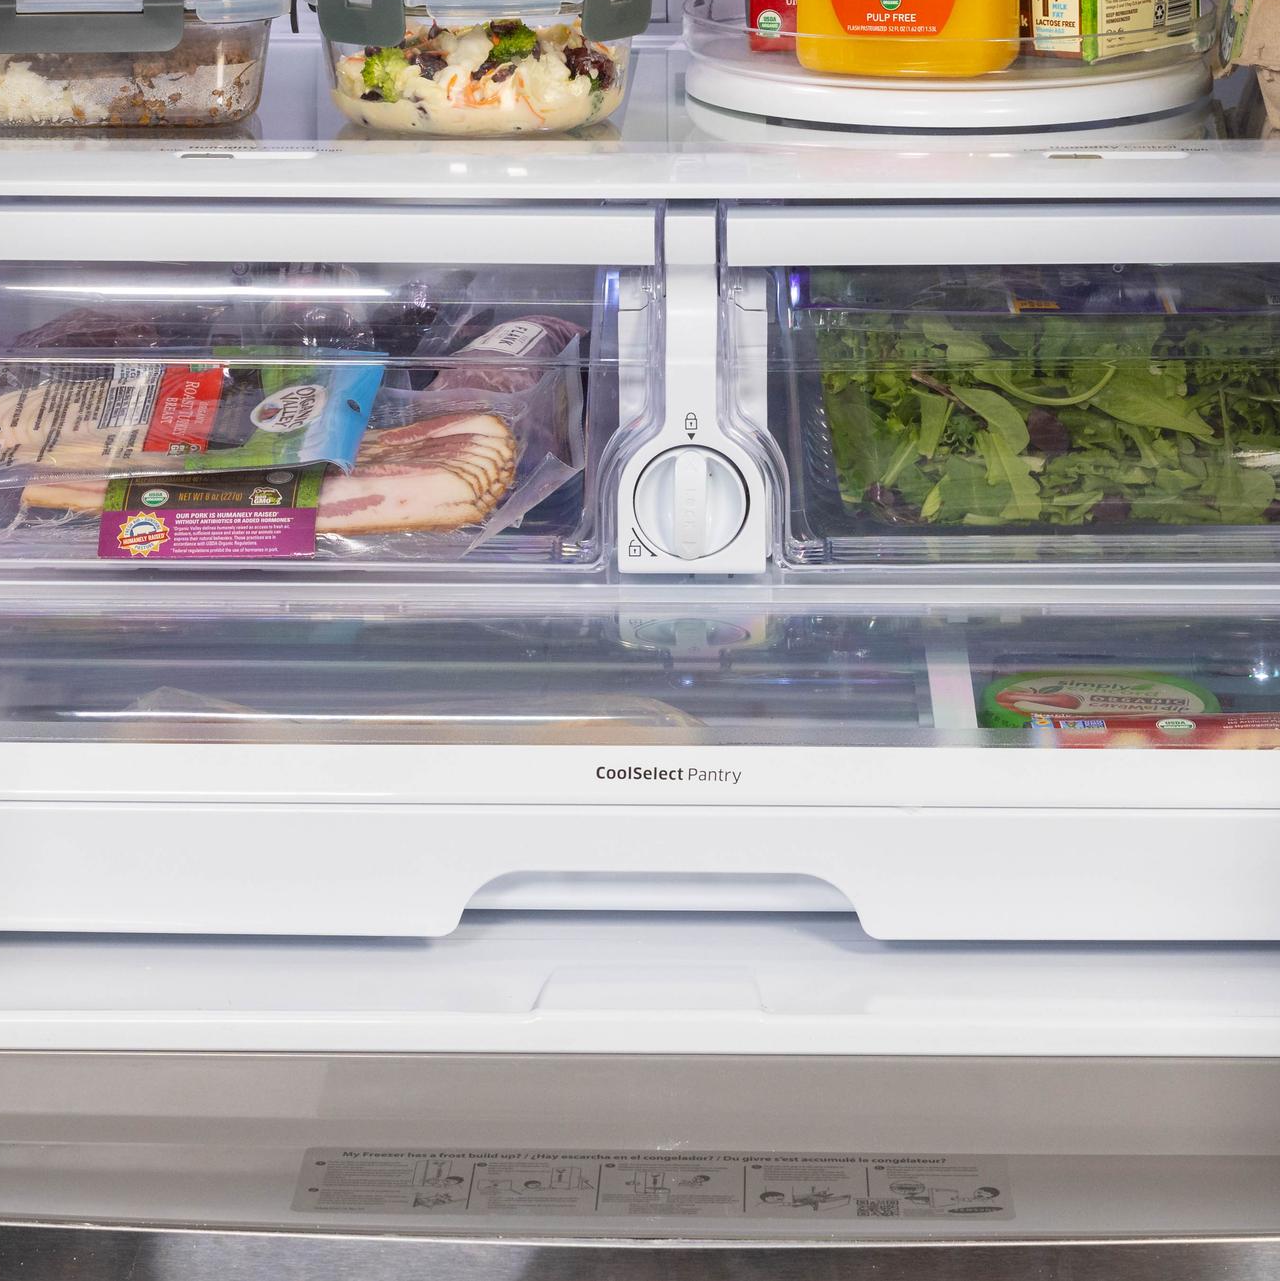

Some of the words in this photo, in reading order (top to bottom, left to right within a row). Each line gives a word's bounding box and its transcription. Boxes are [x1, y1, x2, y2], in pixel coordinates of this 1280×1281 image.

[866, 13, 891, 22] PULP
[893, 13, 916, 22] FREE
[1036, 19, 1060, 27] LACTOSE
[499, 326, 528, 345] FLANK
[1057, 679, 1131, 691] simply
[596, 766, 684, 780] CoolSelect
[688, 768, 742, 784] Pantry
[342, 1151, 360, 1160] My
[500, 1152, 521, 1160] up?
[531, 1153, 558, 1161] ¿Hay
